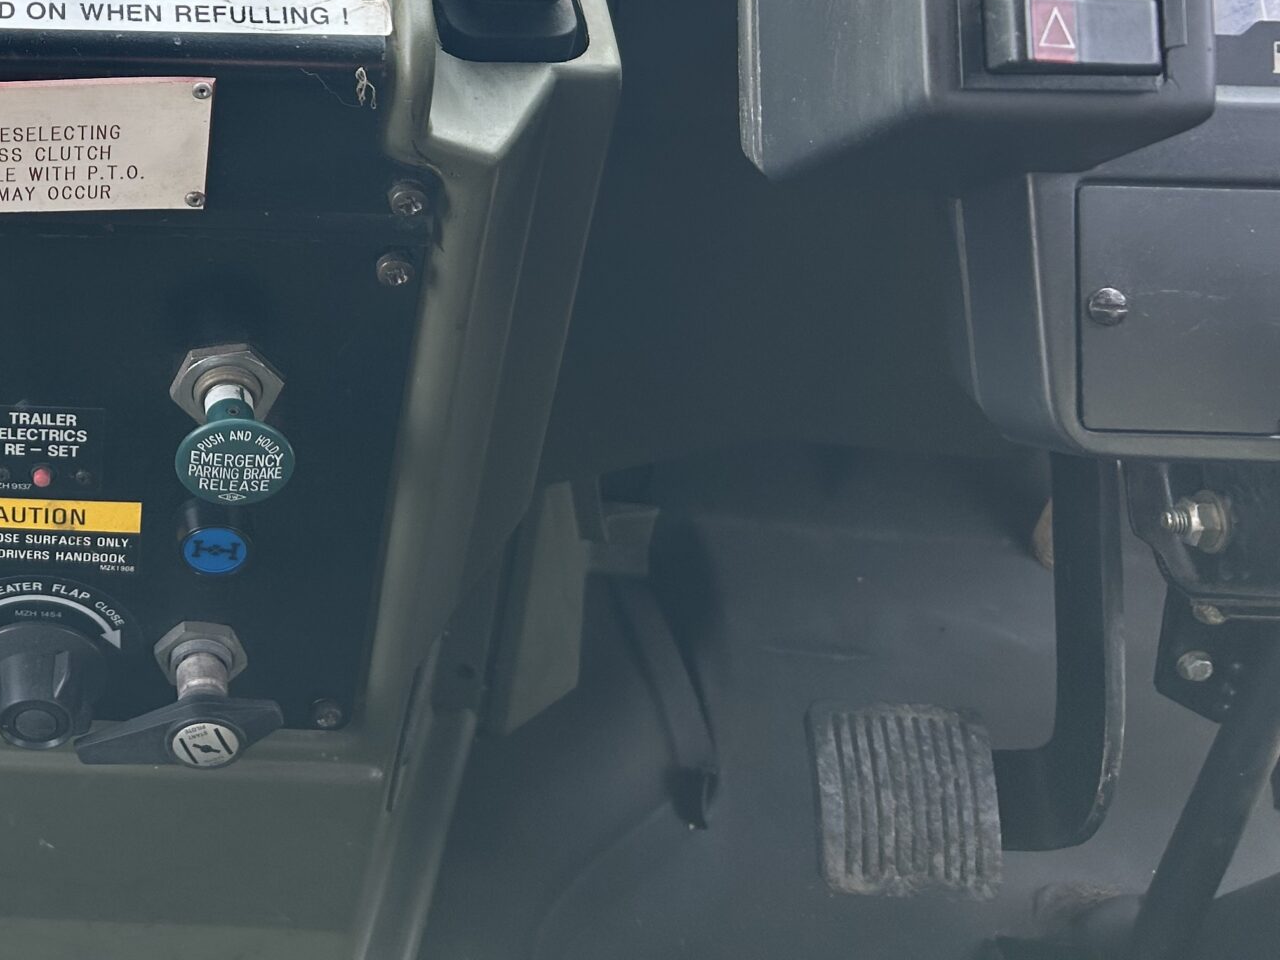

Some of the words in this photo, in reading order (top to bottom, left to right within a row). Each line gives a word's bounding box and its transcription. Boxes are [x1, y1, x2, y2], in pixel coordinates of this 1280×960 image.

[26, 0, 66, 21] ON
[79, 1, 163, 23] WHEN
[175, 4, 330, 26] REFULLING
[35, 145, 112, 161] CLUTCH
[28, 165, 76, 182] WITH
[87, 164, 145, 181] P.T.O.
[47, 184, 111, 201] OCCUR
[9, 411, 77, 427] TRAILER
[197, 432, 225, 452] PUSH
[229, 430, 252, 442] AND
[255, 434, 280, 454] HOLD
[5, 443, 25, 456] RE
[47, 444, 79, 458] SET
[190, 450, 284, 468] EMERGENCY
[188, 464, 240, 480] PARKING
[243, 467, 283, 480] BRAKE
[11, 482, 32, 490] 9137
[198, 477, 270, 492] RELEASE
[25, 534, 91, 546] SURFACES
[55, 551, 126, 564] HANDBOOK
[14, 609, 38, 617] MZH
[51, 583, 91, 602] FLAP
[94, 600, 126, 627] CLOSE
